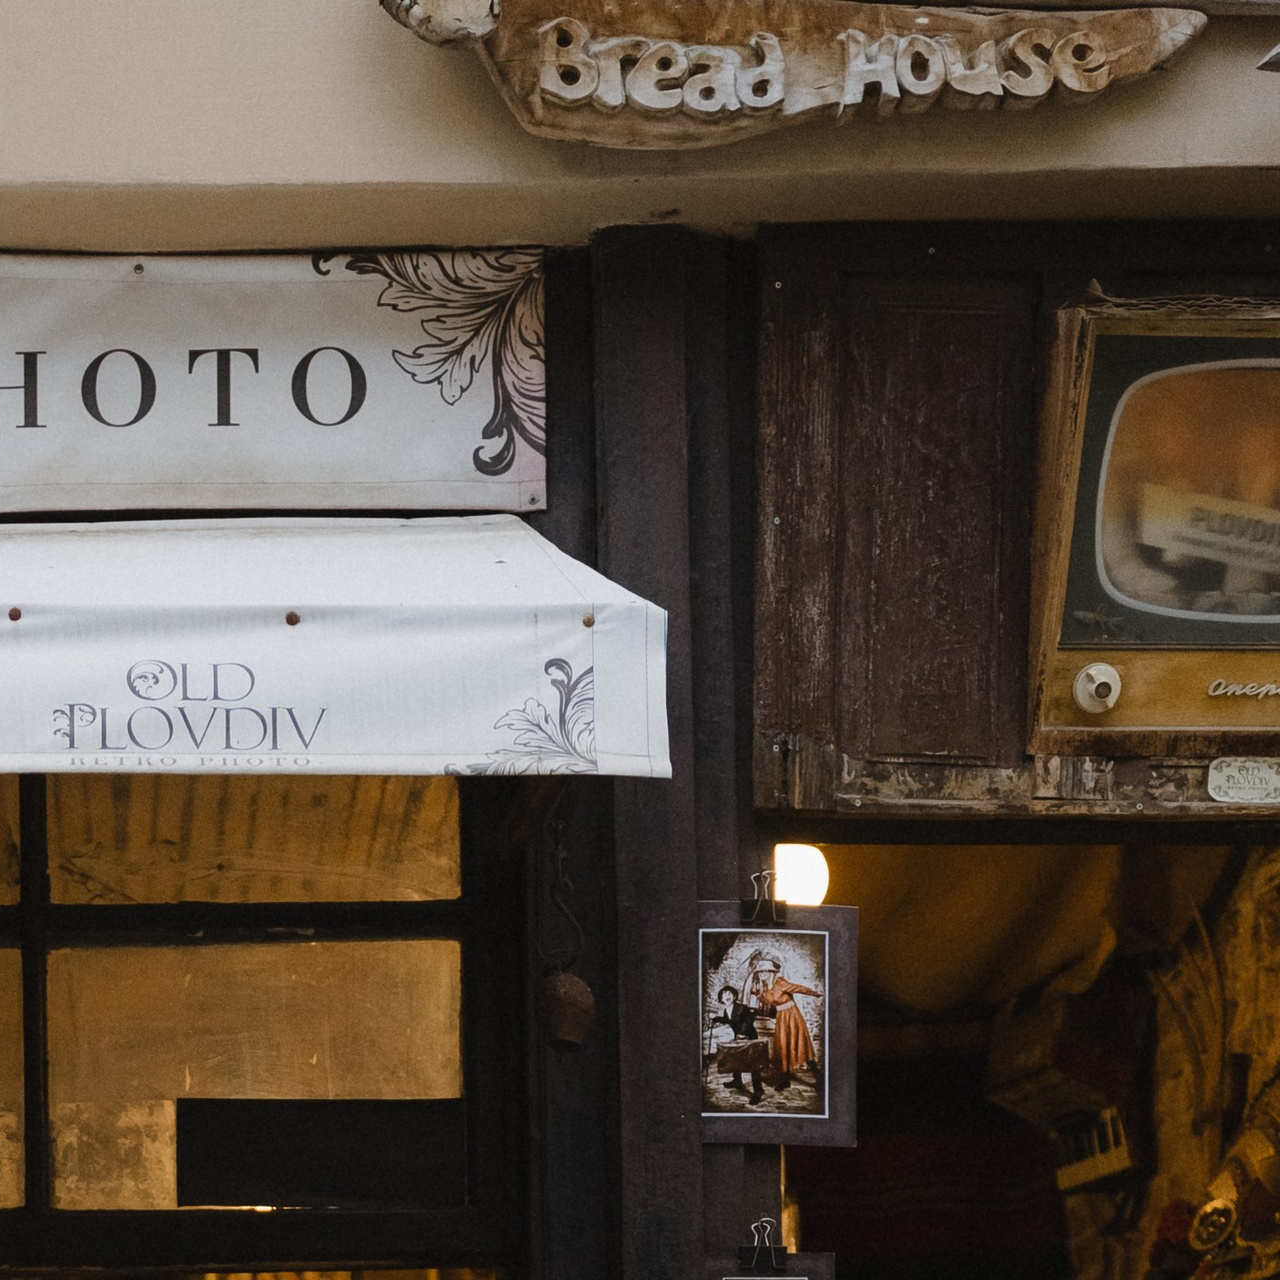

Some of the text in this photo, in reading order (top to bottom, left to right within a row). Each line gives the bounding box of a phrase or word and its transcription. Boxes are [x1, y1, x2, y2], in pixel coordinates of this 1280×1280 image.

[538, 15, 786, 114] Bread
[126, 659, 256, 702] OLD
[52, 702, 329, 751] PLOVDIV
